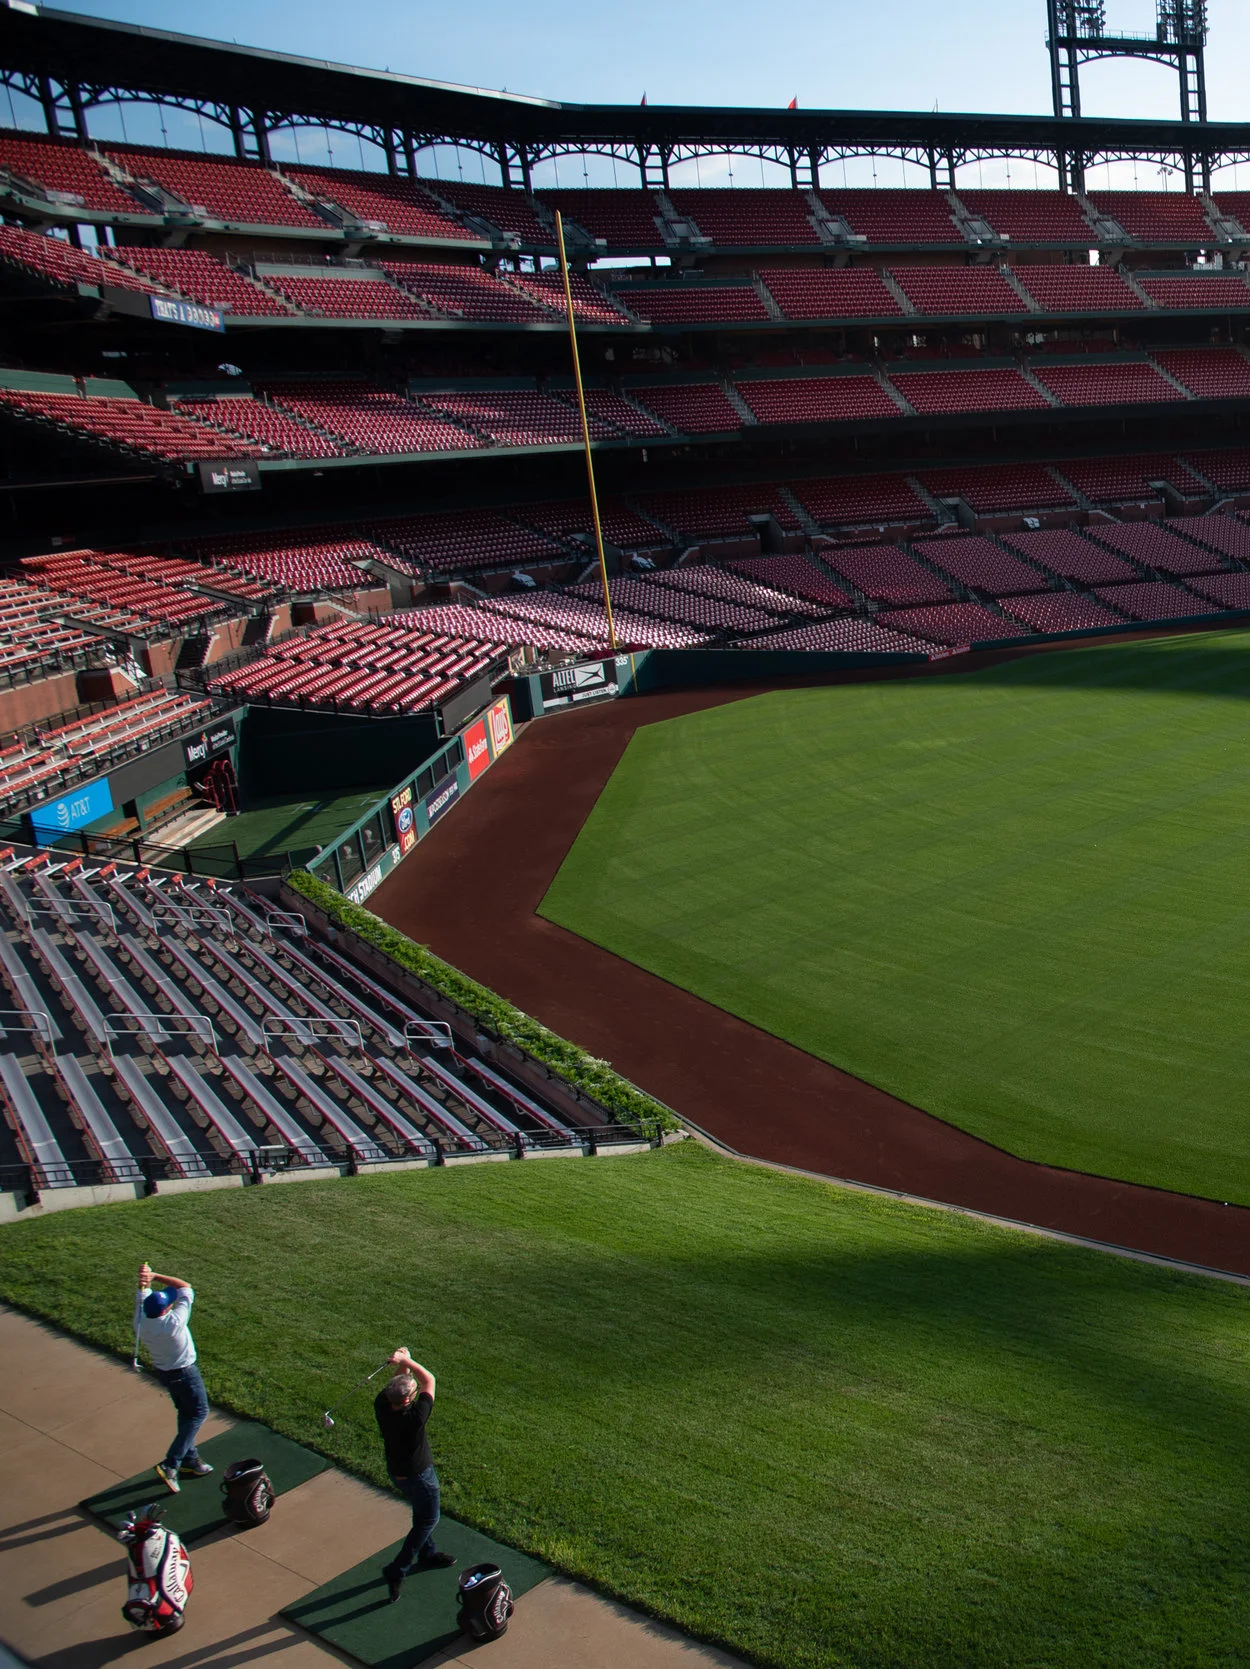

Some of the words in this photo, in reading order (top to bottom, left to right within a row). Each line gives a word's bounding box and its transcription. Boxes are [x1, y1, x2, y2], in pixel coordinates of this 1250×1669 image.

[552, 669, 576, 688] ALTEC
[553, 683, 578, 693] LANSING
[187, 742, 206, 762] Mercy
[71, 797, 90, 820] AT&T
[358, 864, 382, 902] STADIUM
[166, 1547, 184, 1603] Callaway
